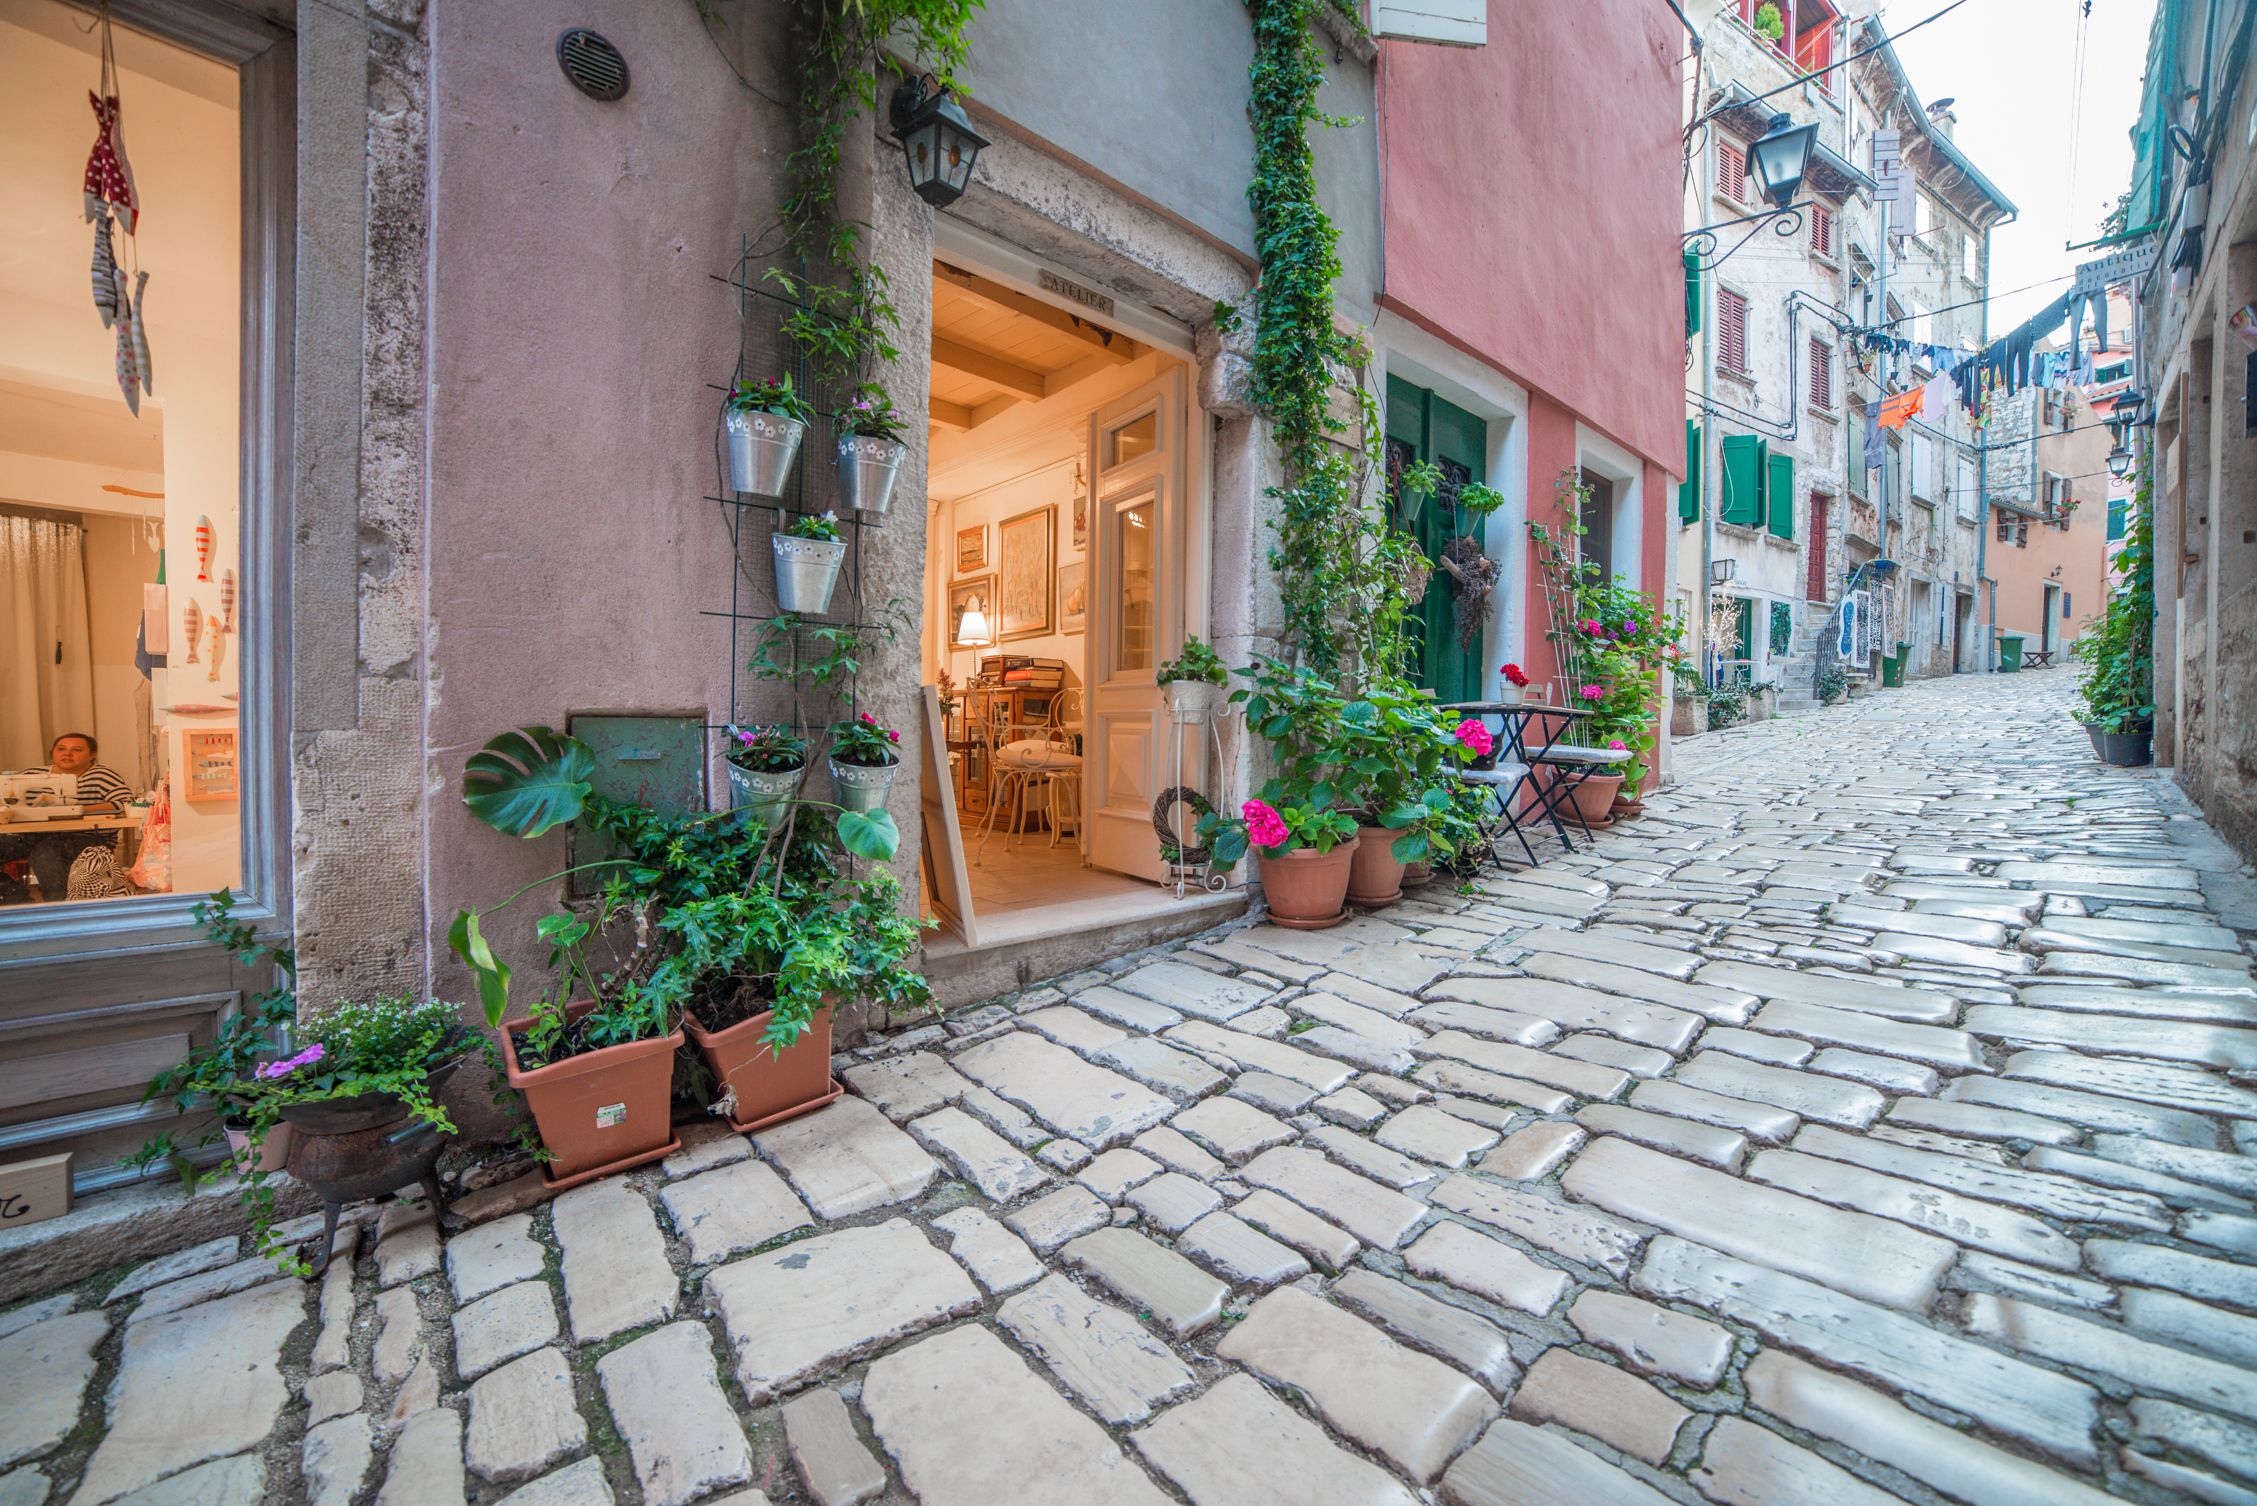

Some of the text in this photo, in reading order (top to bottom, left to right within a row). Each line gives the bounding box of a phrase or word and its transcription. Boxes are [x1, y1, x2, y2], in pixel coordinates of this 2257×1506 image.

[2079, 261, 2150, 285] decorativ
[2080, 244, 2158, 275] Antique
[1050, 277, 1107, 311] ATELIER
